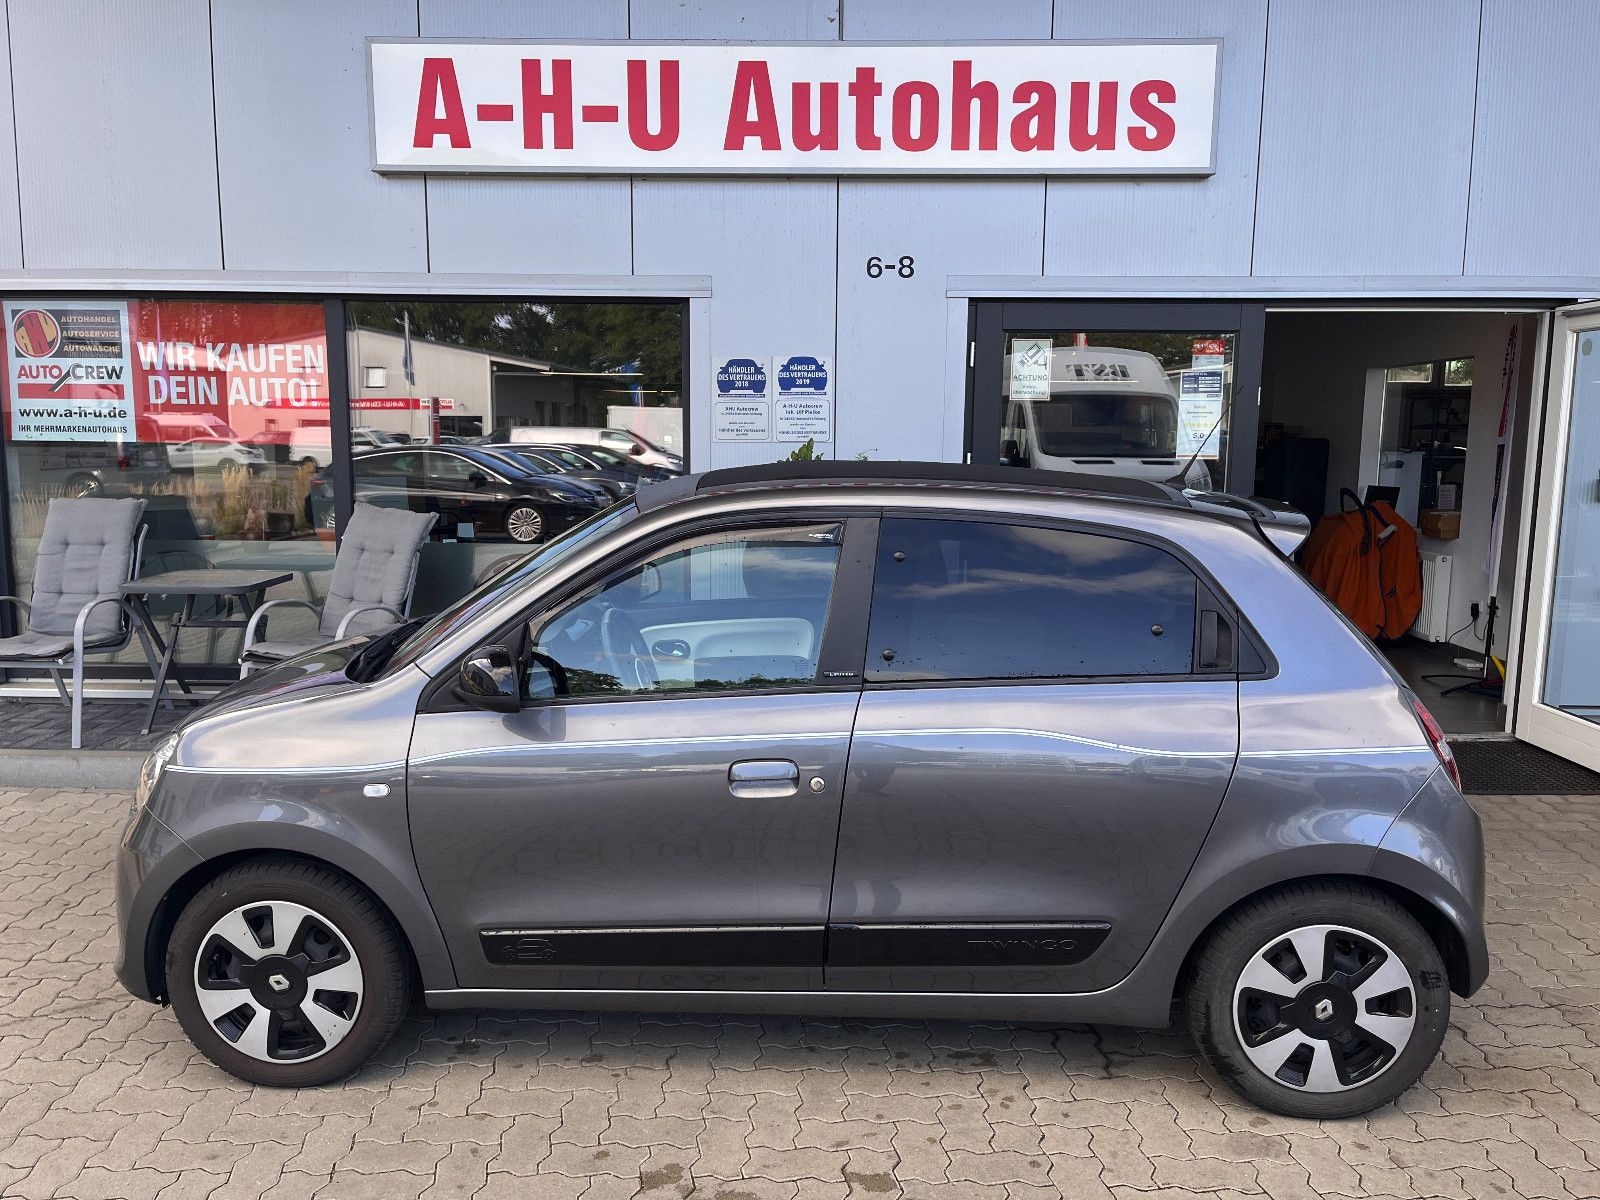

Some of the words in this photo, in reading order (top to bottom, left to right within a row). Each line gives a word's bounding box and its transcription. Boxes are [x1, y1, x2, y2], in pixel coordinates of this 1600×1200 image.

[412, 57, 680, 152] A-H-U
[723, 60, 1177, 152] Autohaus
[866, 255, 915, 279] 6-8
[61, 330, 120, 338] AUTOSERVICE
[136, 341, 197, 371] WIR
[206, 342, 325, 374] KAUFEN
[17, 364, 63, 380] AUTO
[70, 363, 124, 380] CREW
[728, 366, 755, 374] HÄNDLER
[718, 373, 729, 381] DES
[729, 373, 766, 381] VERTRAUENS
[148, 375, 219, 406] DEIN
[227, 377, 318, 407] AUTO!
[18, 406, 128, 419] www.a-h-u.de
[18, 424, 32, 433] IHR
[33, 424, 128, 434] MEHRMARKENAUTOHAUS
[967, 939, 1079, 952] TWINGO
